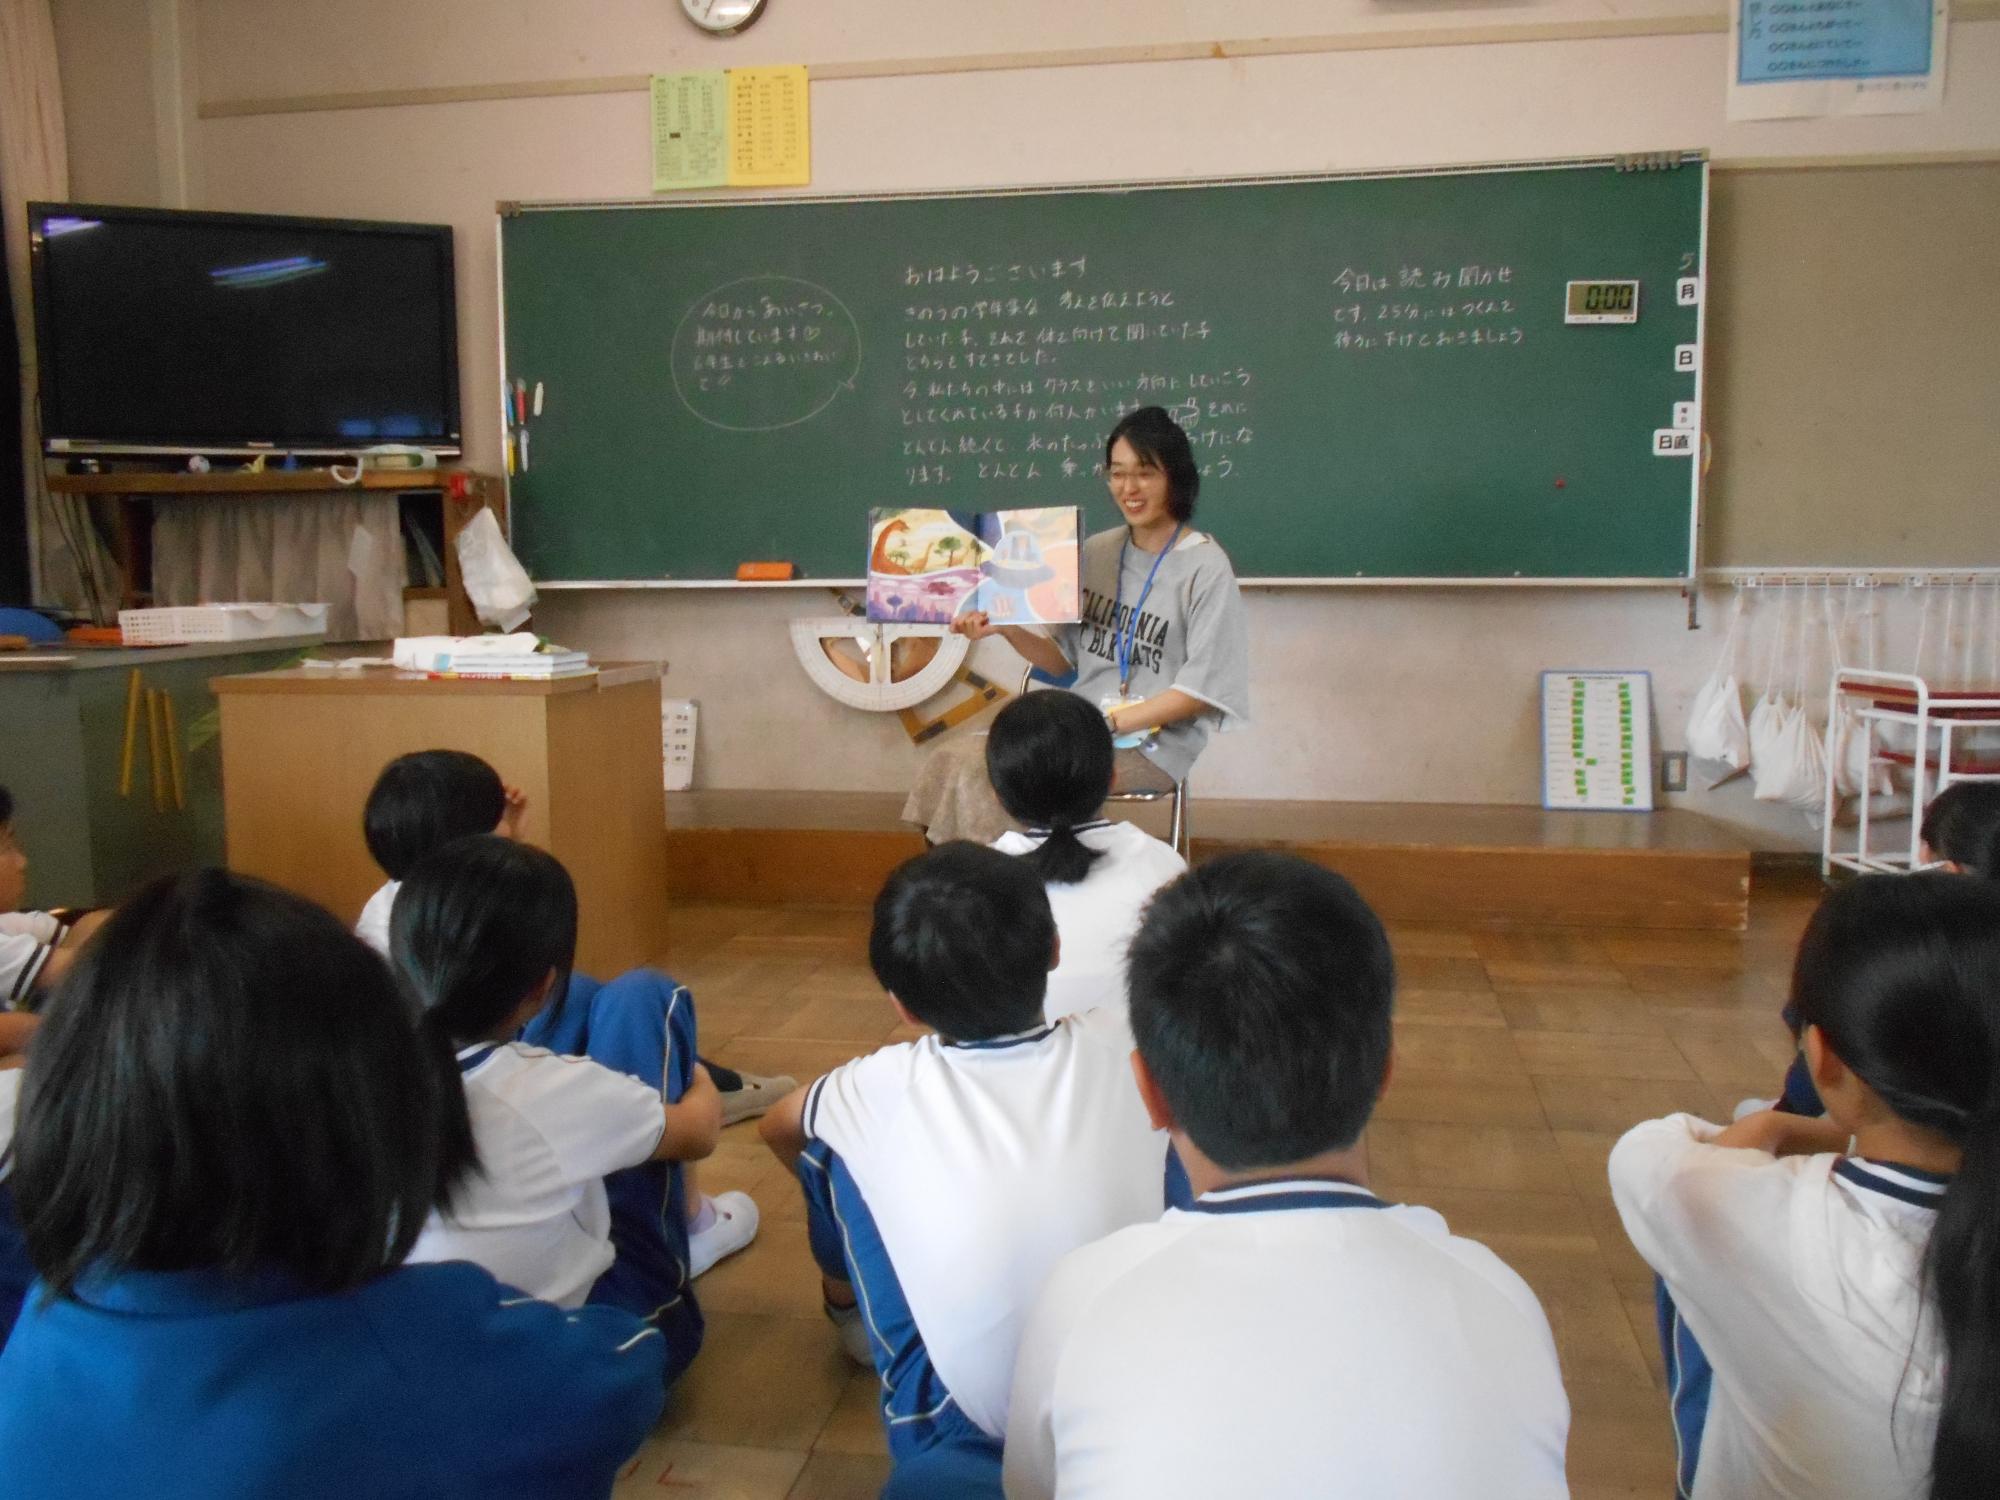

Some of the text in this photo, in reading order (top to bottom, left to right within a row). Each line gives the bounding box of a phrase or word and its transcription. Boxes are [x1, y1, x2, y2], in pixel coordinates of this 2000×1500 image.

[1682, 283, 1695, 300] 月
[1679, 350, 1693, 365] 日
[1659, 434, 1690, 450] 日直
[1083, 588, 1169, 648] ALIFORNIA
